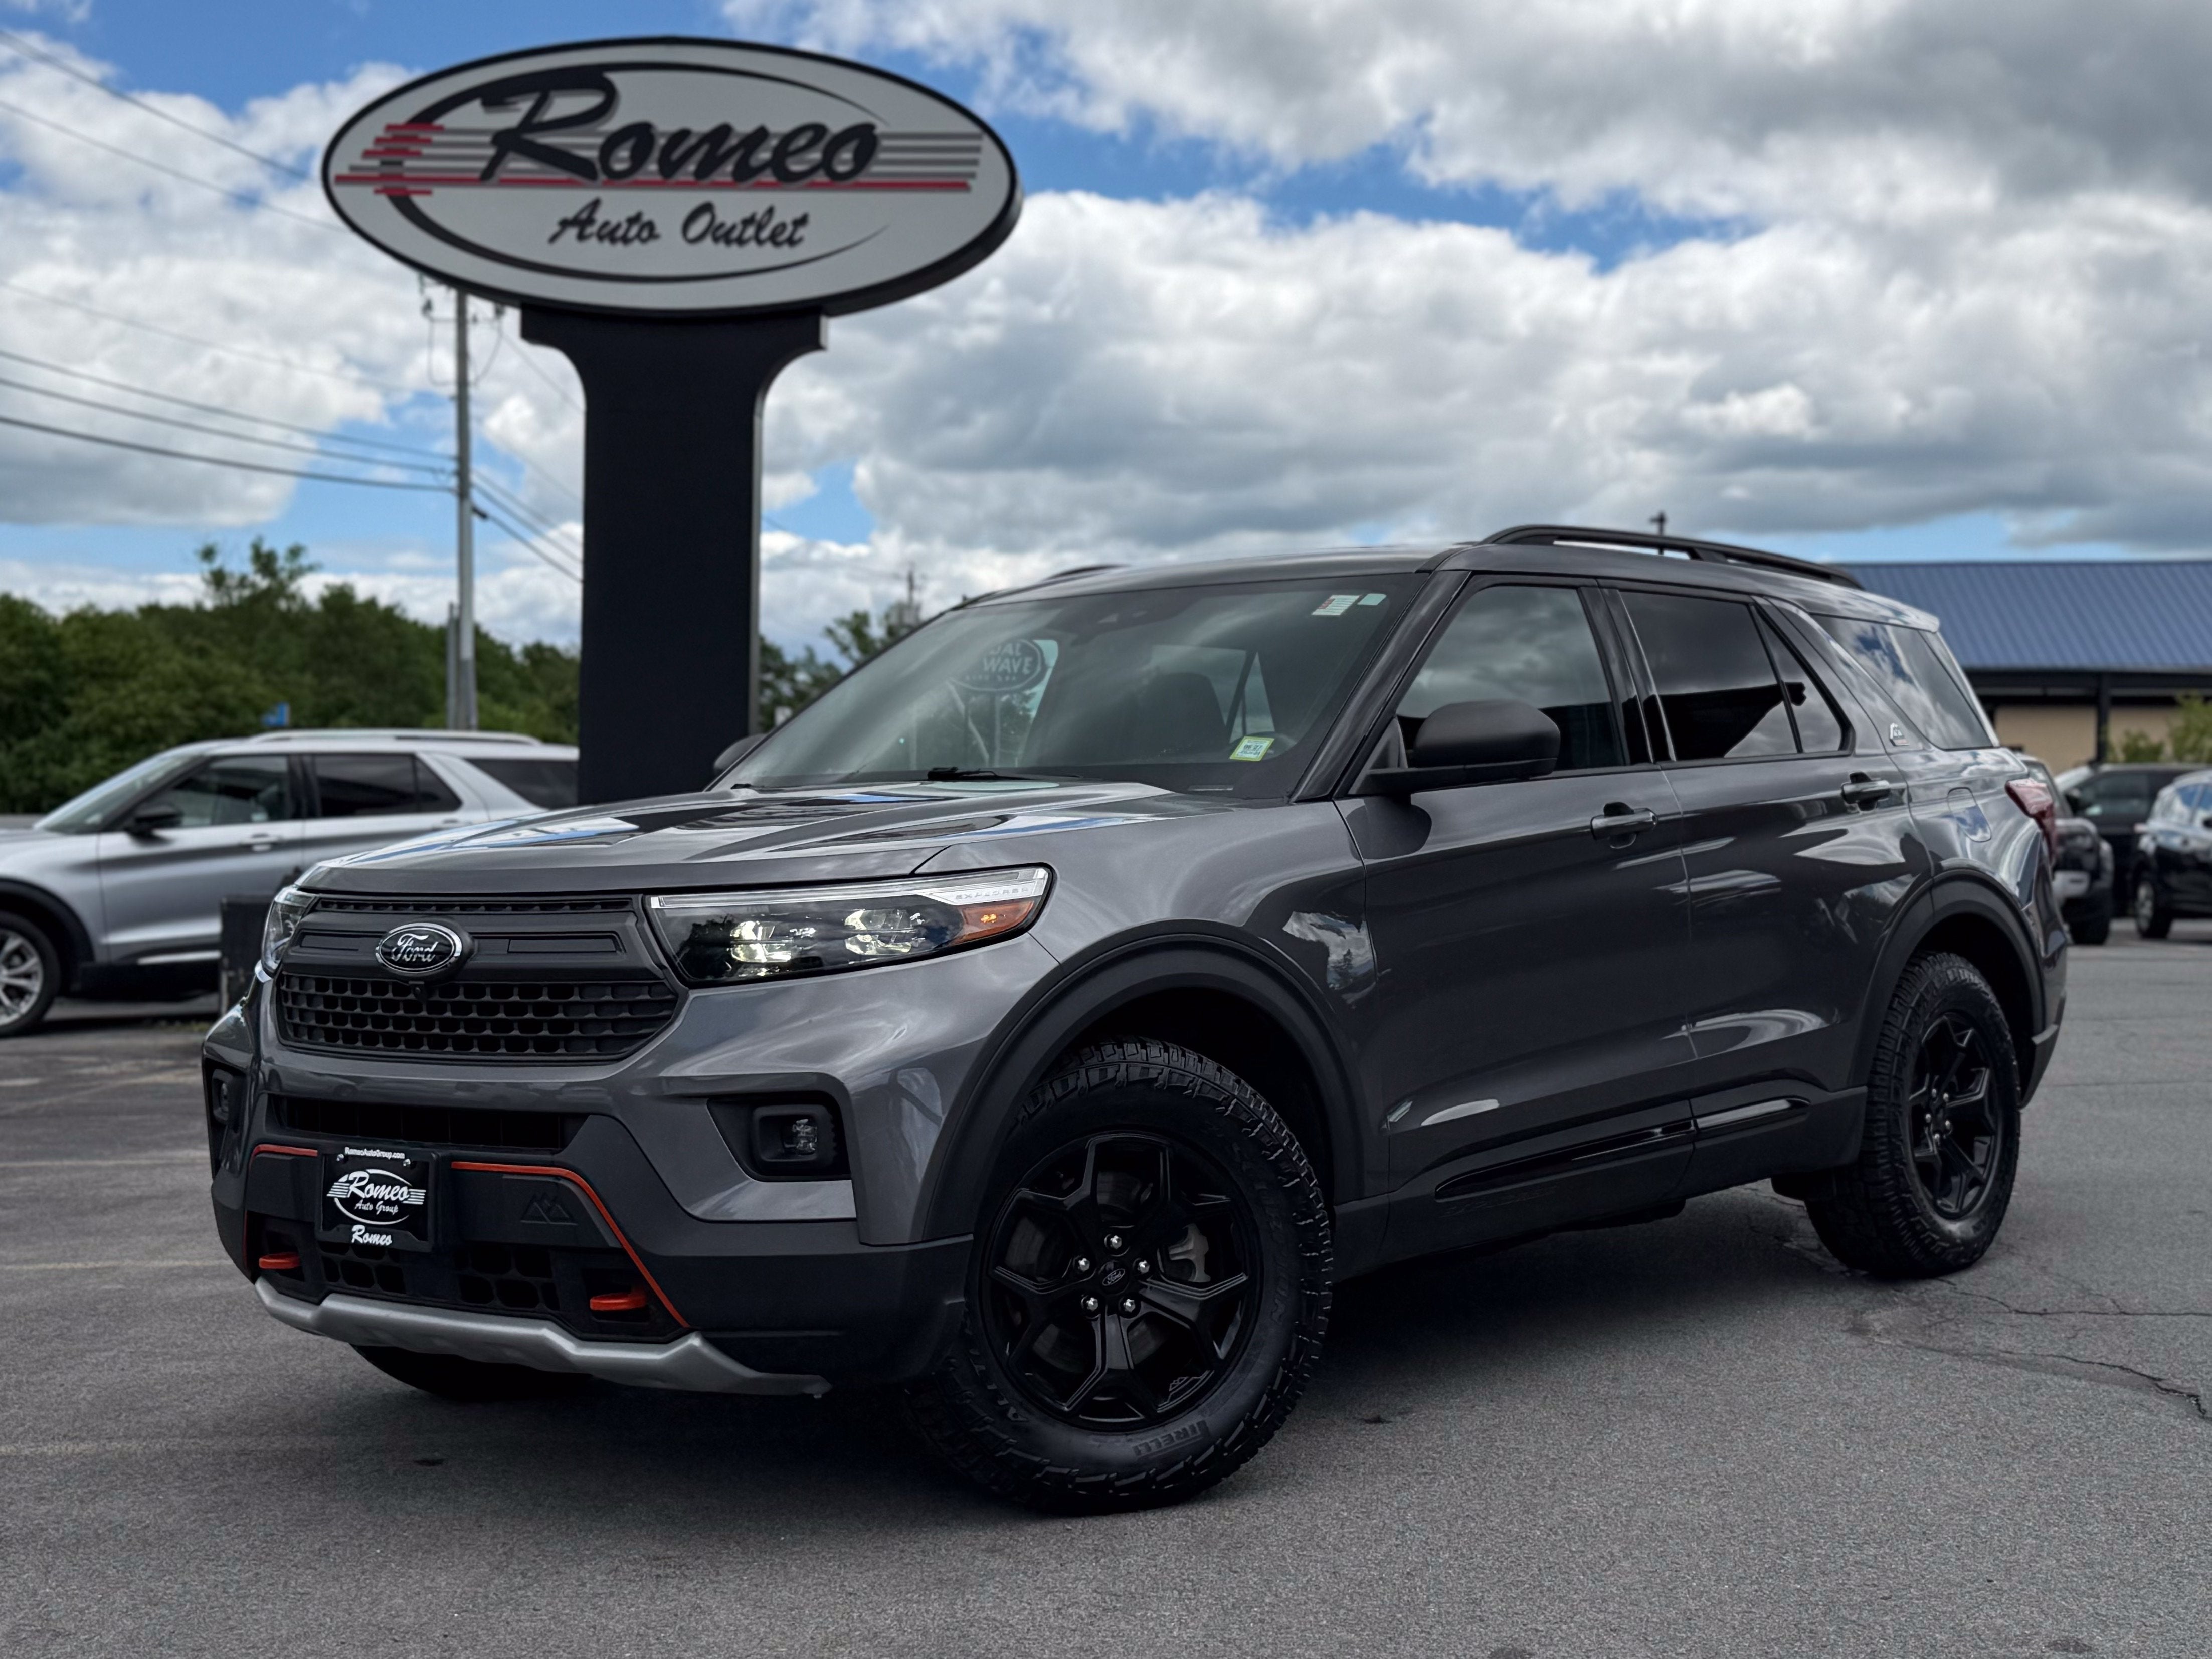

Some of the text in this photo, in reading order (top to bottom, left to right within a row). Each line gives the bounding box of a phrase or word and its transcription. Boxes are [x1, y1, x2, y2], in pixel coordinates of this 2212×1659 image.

[479, 65, 879, 185] Romeo
[548, 196, 810, 249] Auto Outlet
[983, 657, 1033, 675] WAVE
[391, 933, 439, 962] Ford
[344, 1146, 405, 1160] RomeoAutoGroup.com
[346, 1171, 410, 1201] Romeo
[354, 1199, 399, 1215] Auto Group
[351, 1224, 392, 1246] Romeo
[1107, 1271, 1122, 1284] Ford
